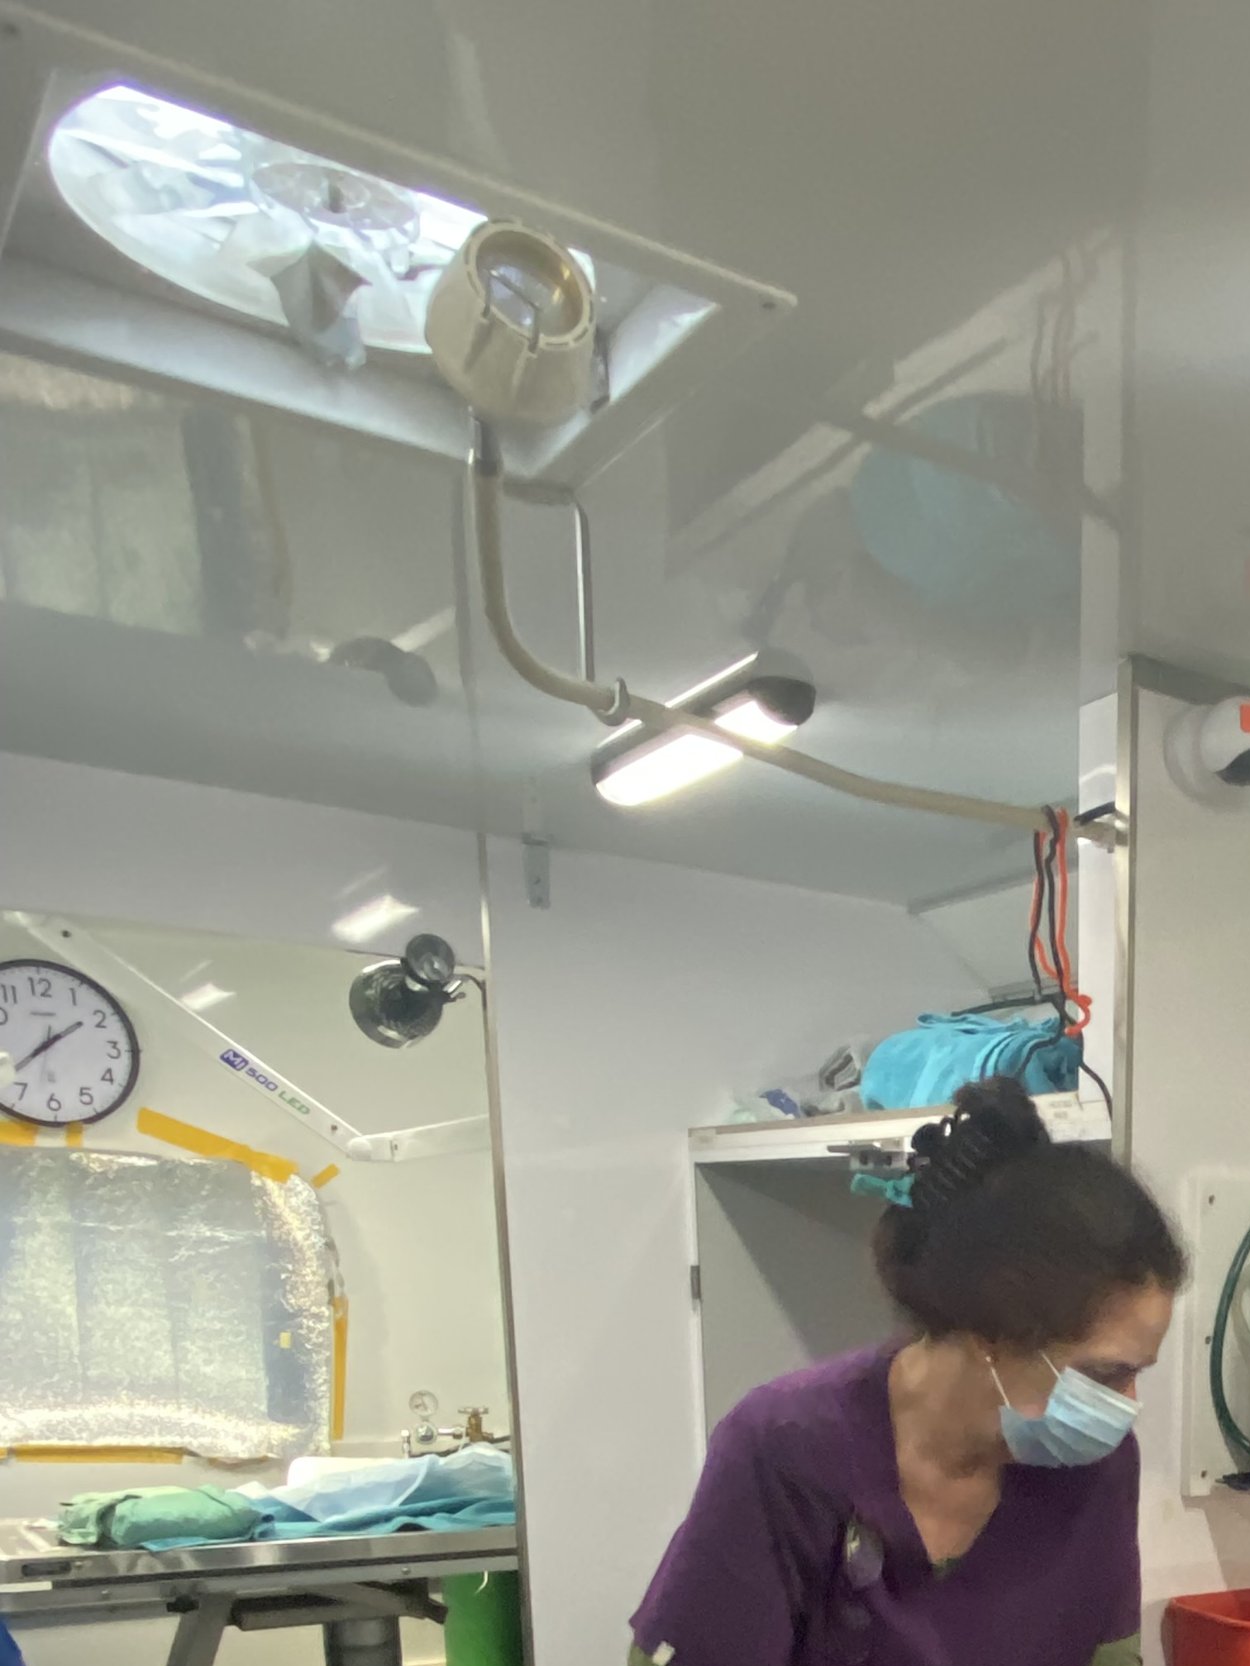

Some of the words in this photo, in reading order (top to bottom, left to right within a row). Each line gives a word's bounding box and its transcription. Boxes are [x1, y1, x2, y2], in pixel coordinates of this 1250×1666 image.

[1, 984, 17, 1004] 11
[27, 976, 52, 998] 12
[69, 987, 77, 1006] 1
[92, 1009, 107, 1029] 2
[106, 1040, 121, 1060] 3
[100, 1067, 115, 1085] 4
[13, 1081, 28, 1101] 7
[79, 1086, 94, 1106] 5
[245, 1067, 278, 1092] 500
[278, 1090, 310, 1115] LED
[46, 1092, 62, 1112] 6
